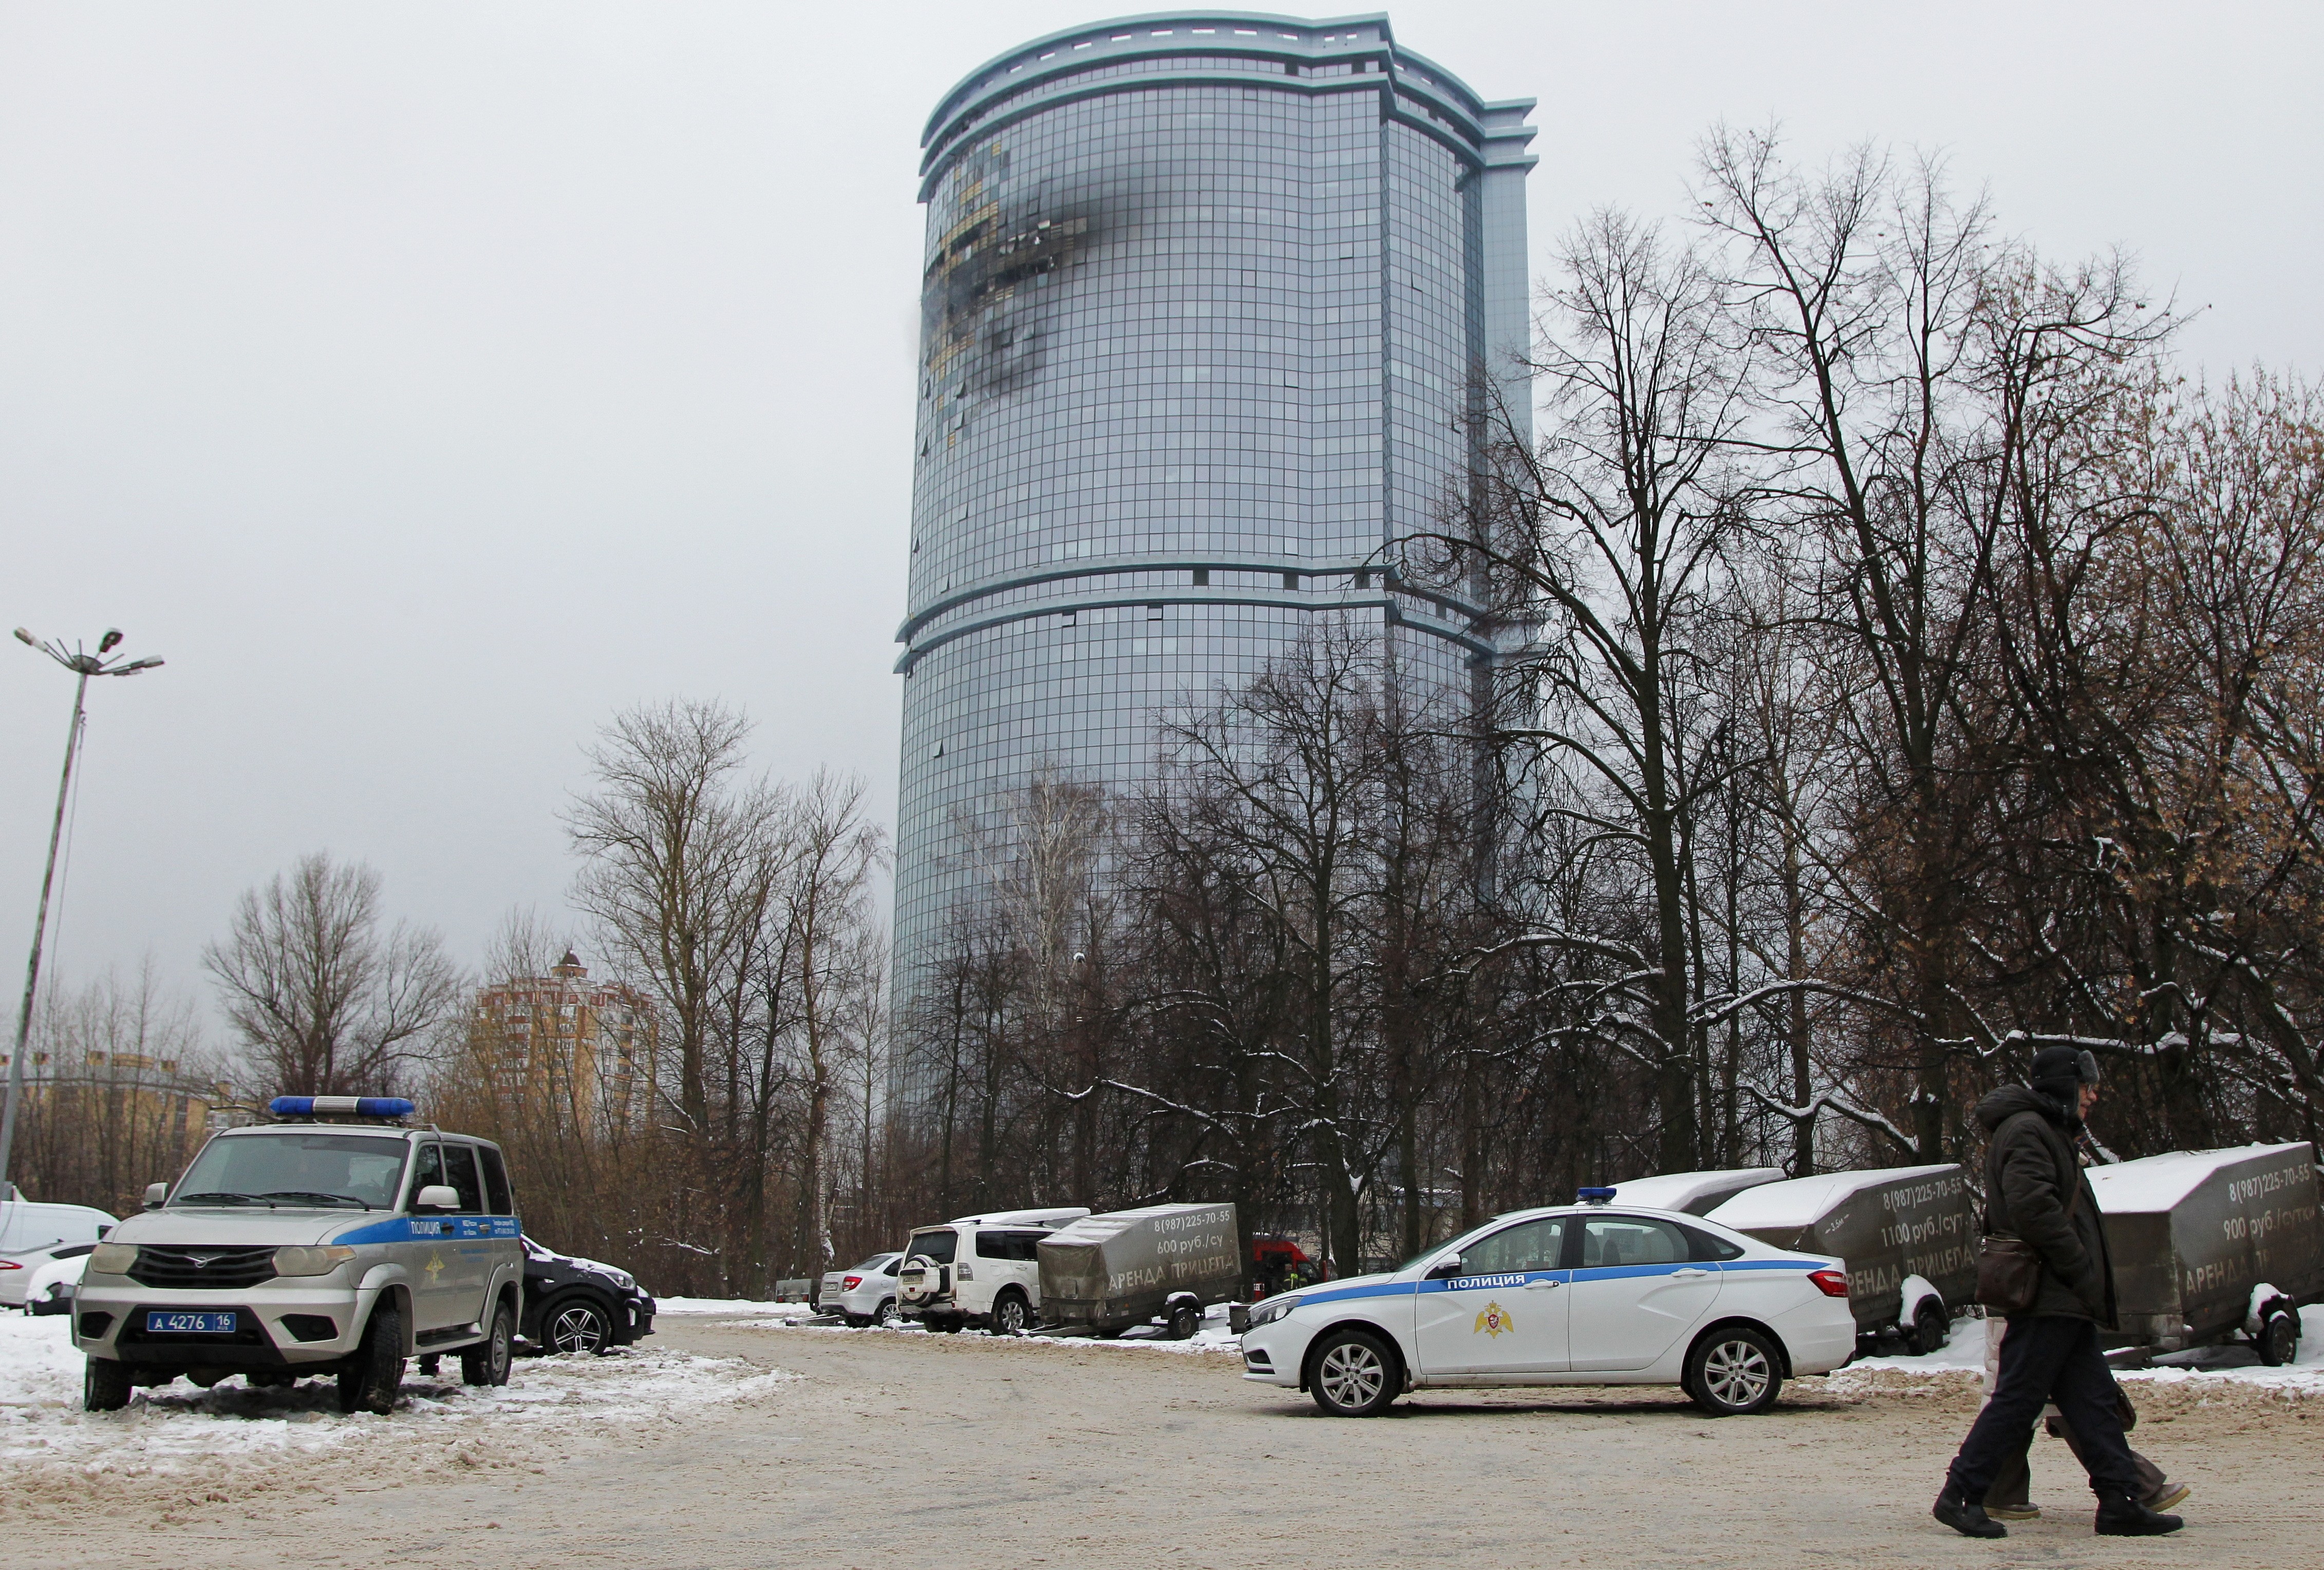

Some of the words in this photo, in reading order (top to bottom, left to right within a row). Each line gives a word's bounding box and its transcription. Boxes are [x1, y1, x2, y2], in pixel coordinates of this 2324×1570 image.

[1883, 1177, 1963, 1213] 8(987)225-70-55
[2229, 1163, 2310, 1204] 8(987)225-70-55
[410, 1221, 441, 1237] ПОЛИЦИЯ
[1154, 1210, 1230, 1234] 8(987)225-70-55
[2223, 1217, 2246, 1240] 900
[1157, 1239, 1177, 1254] 600
[1881, 1222, 1910, 1247] 1100
[1108, 1265, 1167, 1292] АРЕНДА
[1846, 1264, 1902, 1297] РЕНДА
[1907, 1243, 1974, 1277] ПРИЦЕПА
[1448, 1275, 1526, 1290] ПОЛИЦИЯ
[155, 1318, 163, 1329] А
[168, 1315, 205, 1330] 4276
[217, 1315, 230, 1325] 16
